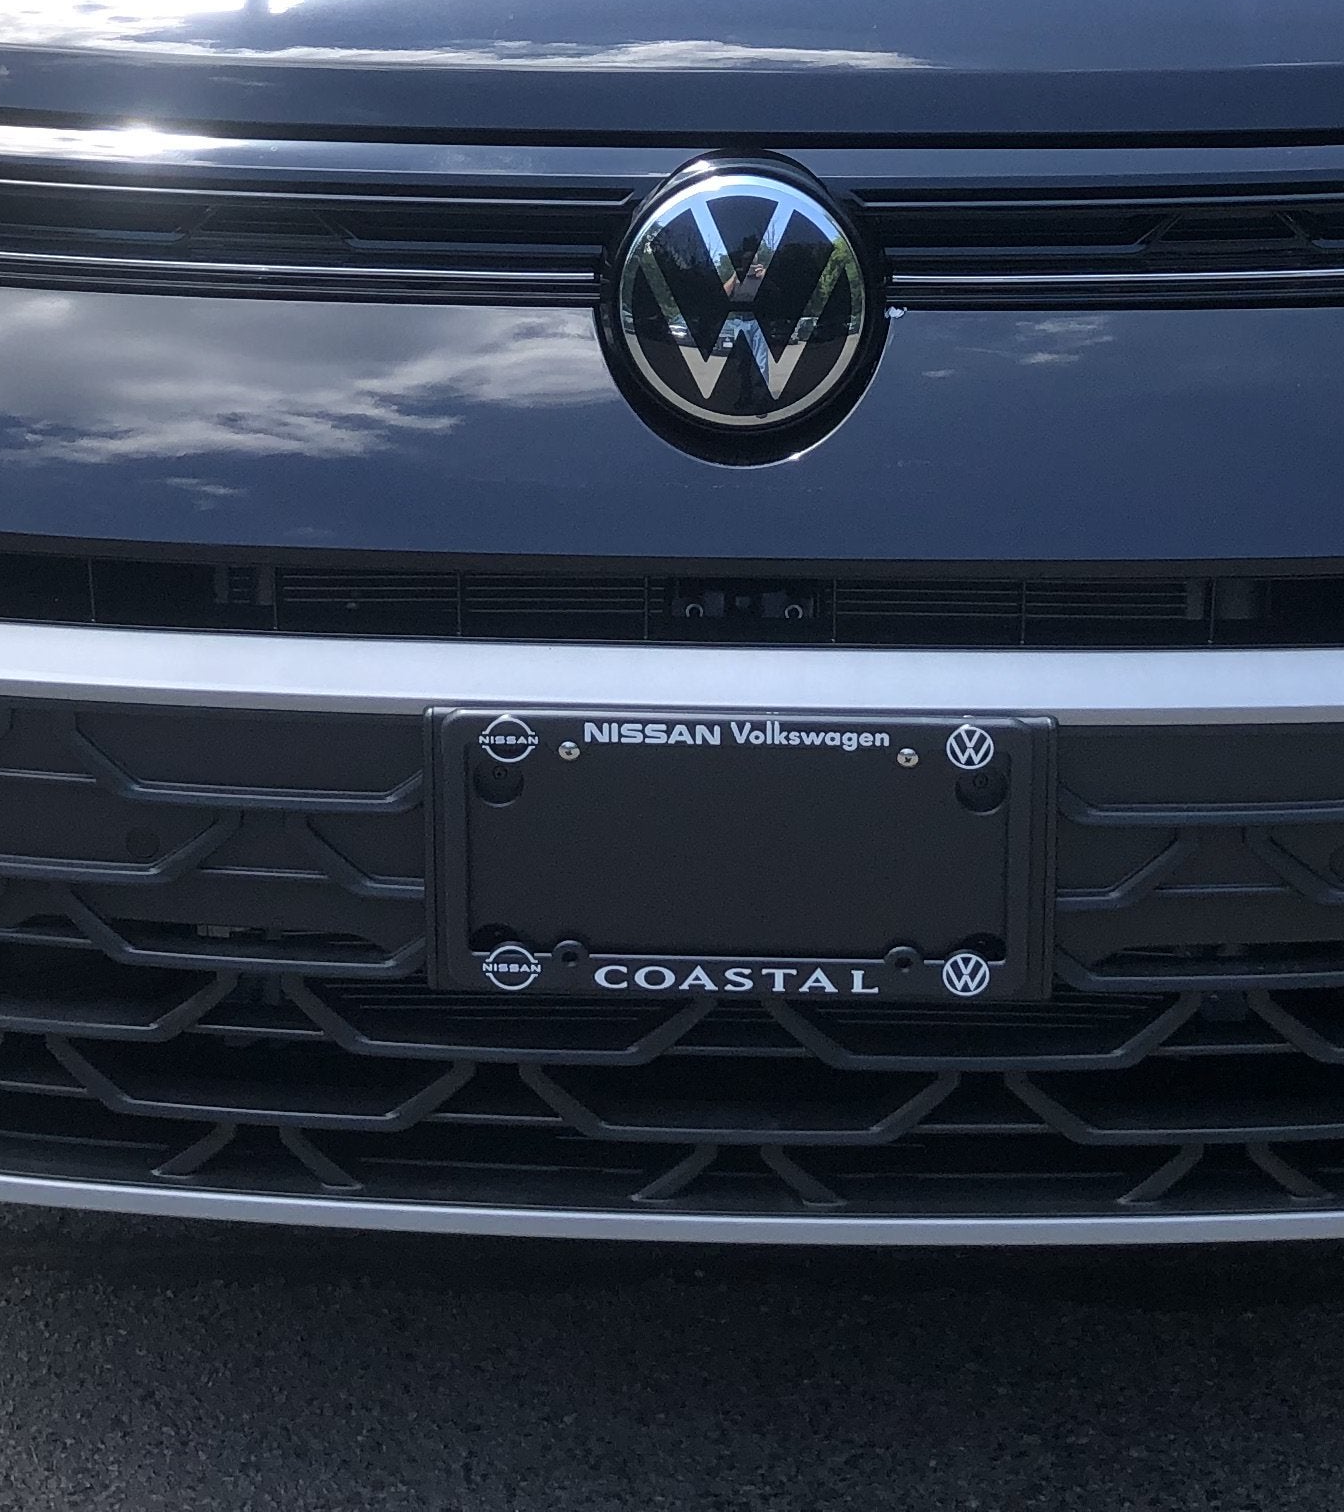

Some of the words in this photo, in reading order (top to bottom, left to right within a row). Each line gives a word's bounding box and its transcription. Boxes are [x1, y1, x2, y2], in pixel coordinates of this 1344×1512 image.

[478, 735, 539, 745] NISSAN
[584, 722, 721, 746] NISSAN
[730, 721, 890, 752] Volkswagen
[482, 962, 542, 973] NISSAN
[594, 966, 879, 994] COASTAL
